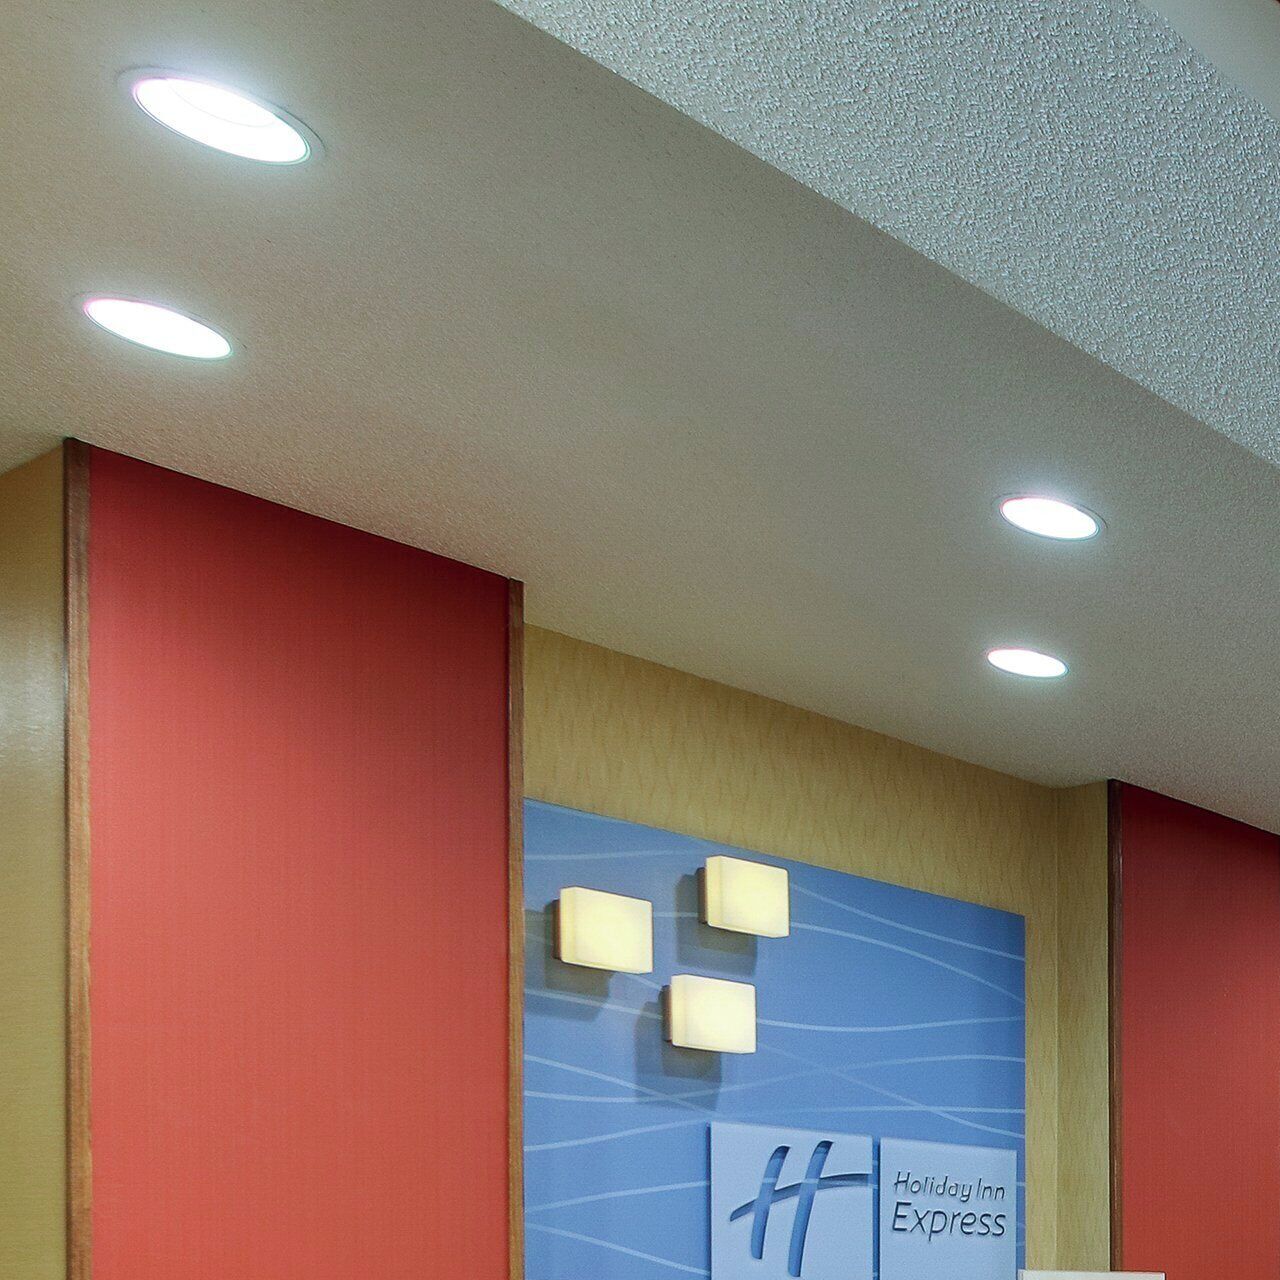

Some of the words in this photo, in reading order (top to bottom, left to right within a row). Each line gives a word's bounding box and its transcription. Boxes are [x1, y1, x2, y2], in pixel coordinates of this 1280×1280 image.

[893, 1170, 972, 1203] Holiday
[976, 1177, 1005, 1200] Inn
[892, 1201, 1006, 1242] Express
